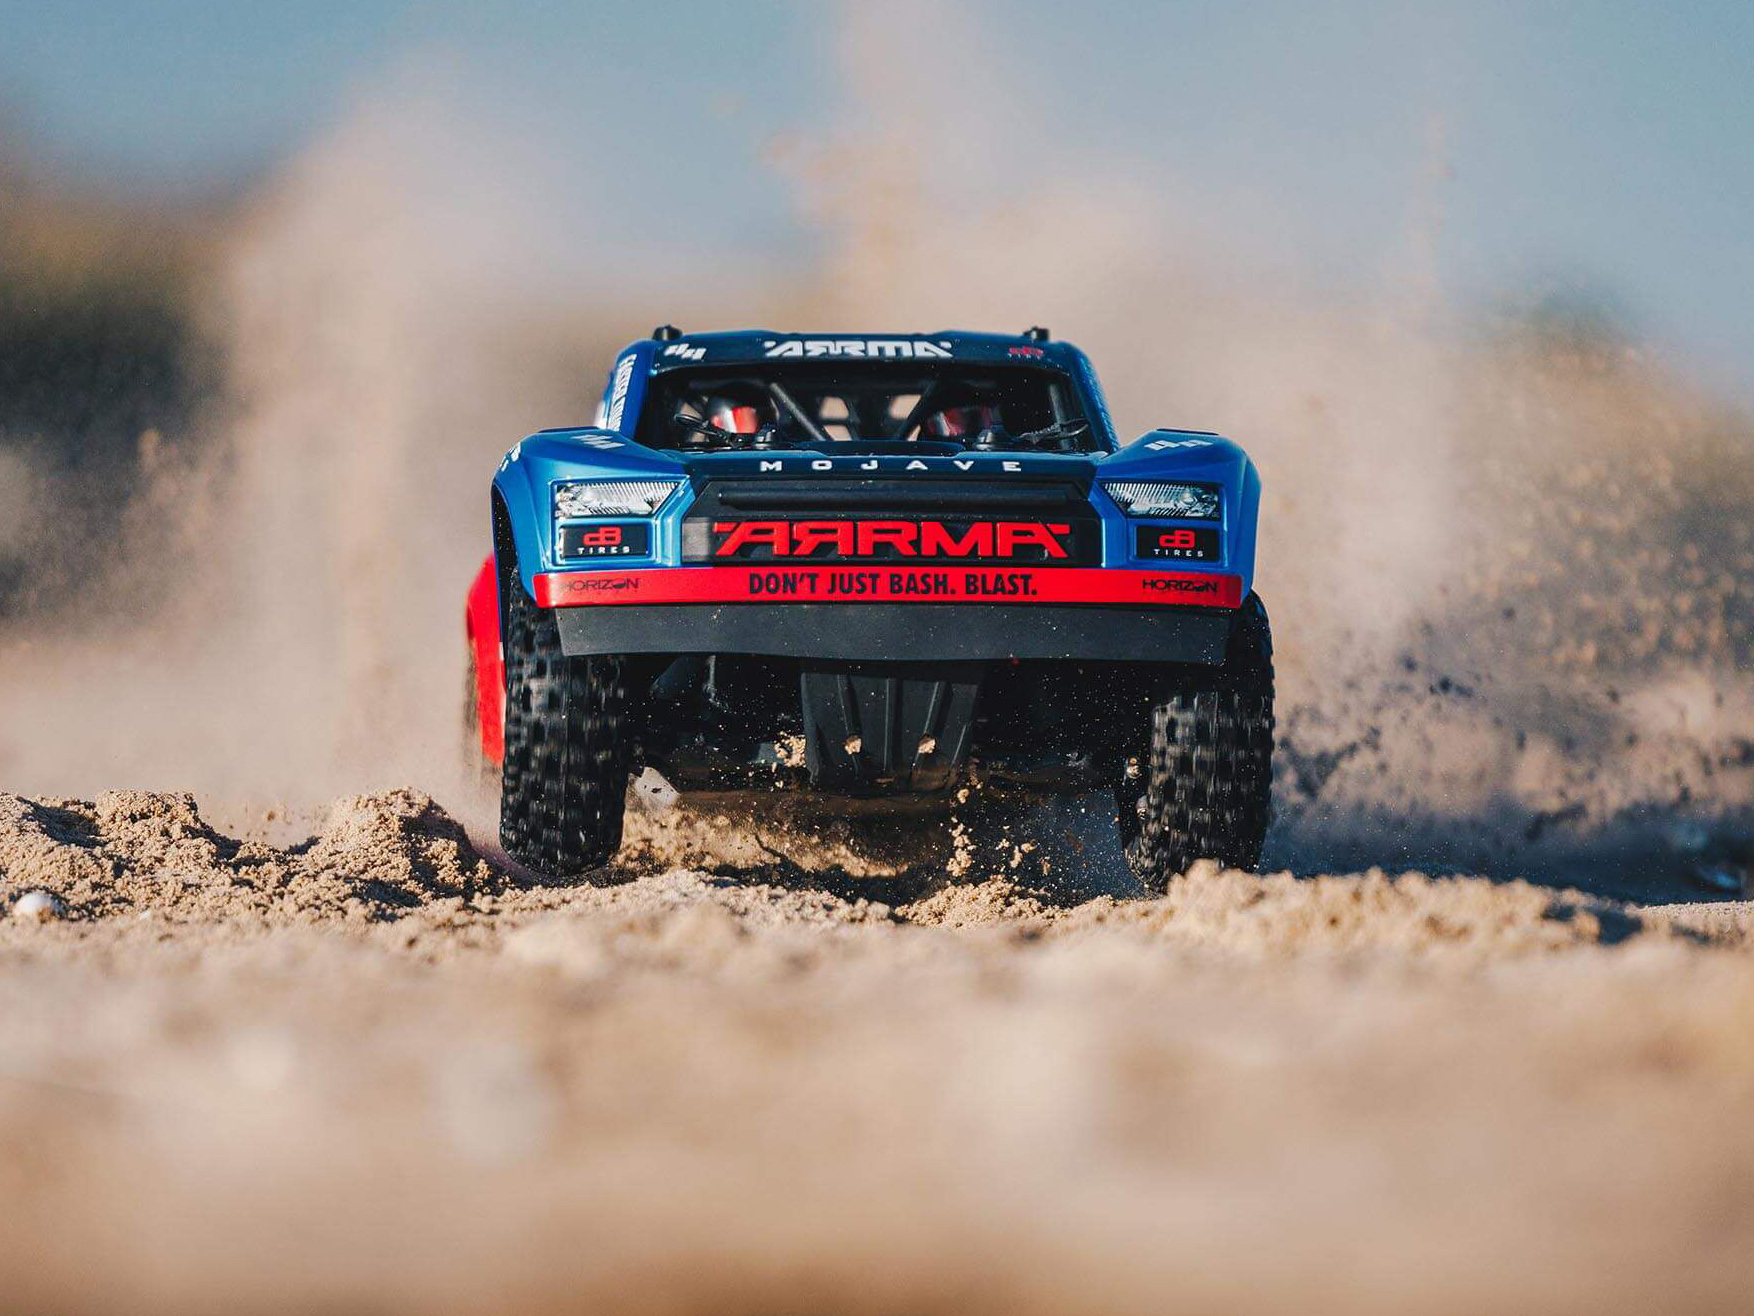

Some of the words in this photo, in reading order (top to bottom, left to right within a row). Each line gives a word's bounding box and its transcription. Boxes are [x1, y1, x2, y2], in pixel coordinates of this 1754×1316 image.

[764, 341, 953, 358] ARRMA
[759, 459, 1022, 472] MOJAVE
[712, 521, 1070, 558] ARRMA
[577, 546, 630, 555] TIRES
[1154, 548, 1204, 557] TIRES
[749, 573, 820, 595] DON'T
[827, 573, 881, 595] JUST
[889, 573, 956, 595] BASH.
[964, 573, 1038, 596] BLAST.
[1141, 579, 1218, 593] HORIZON
